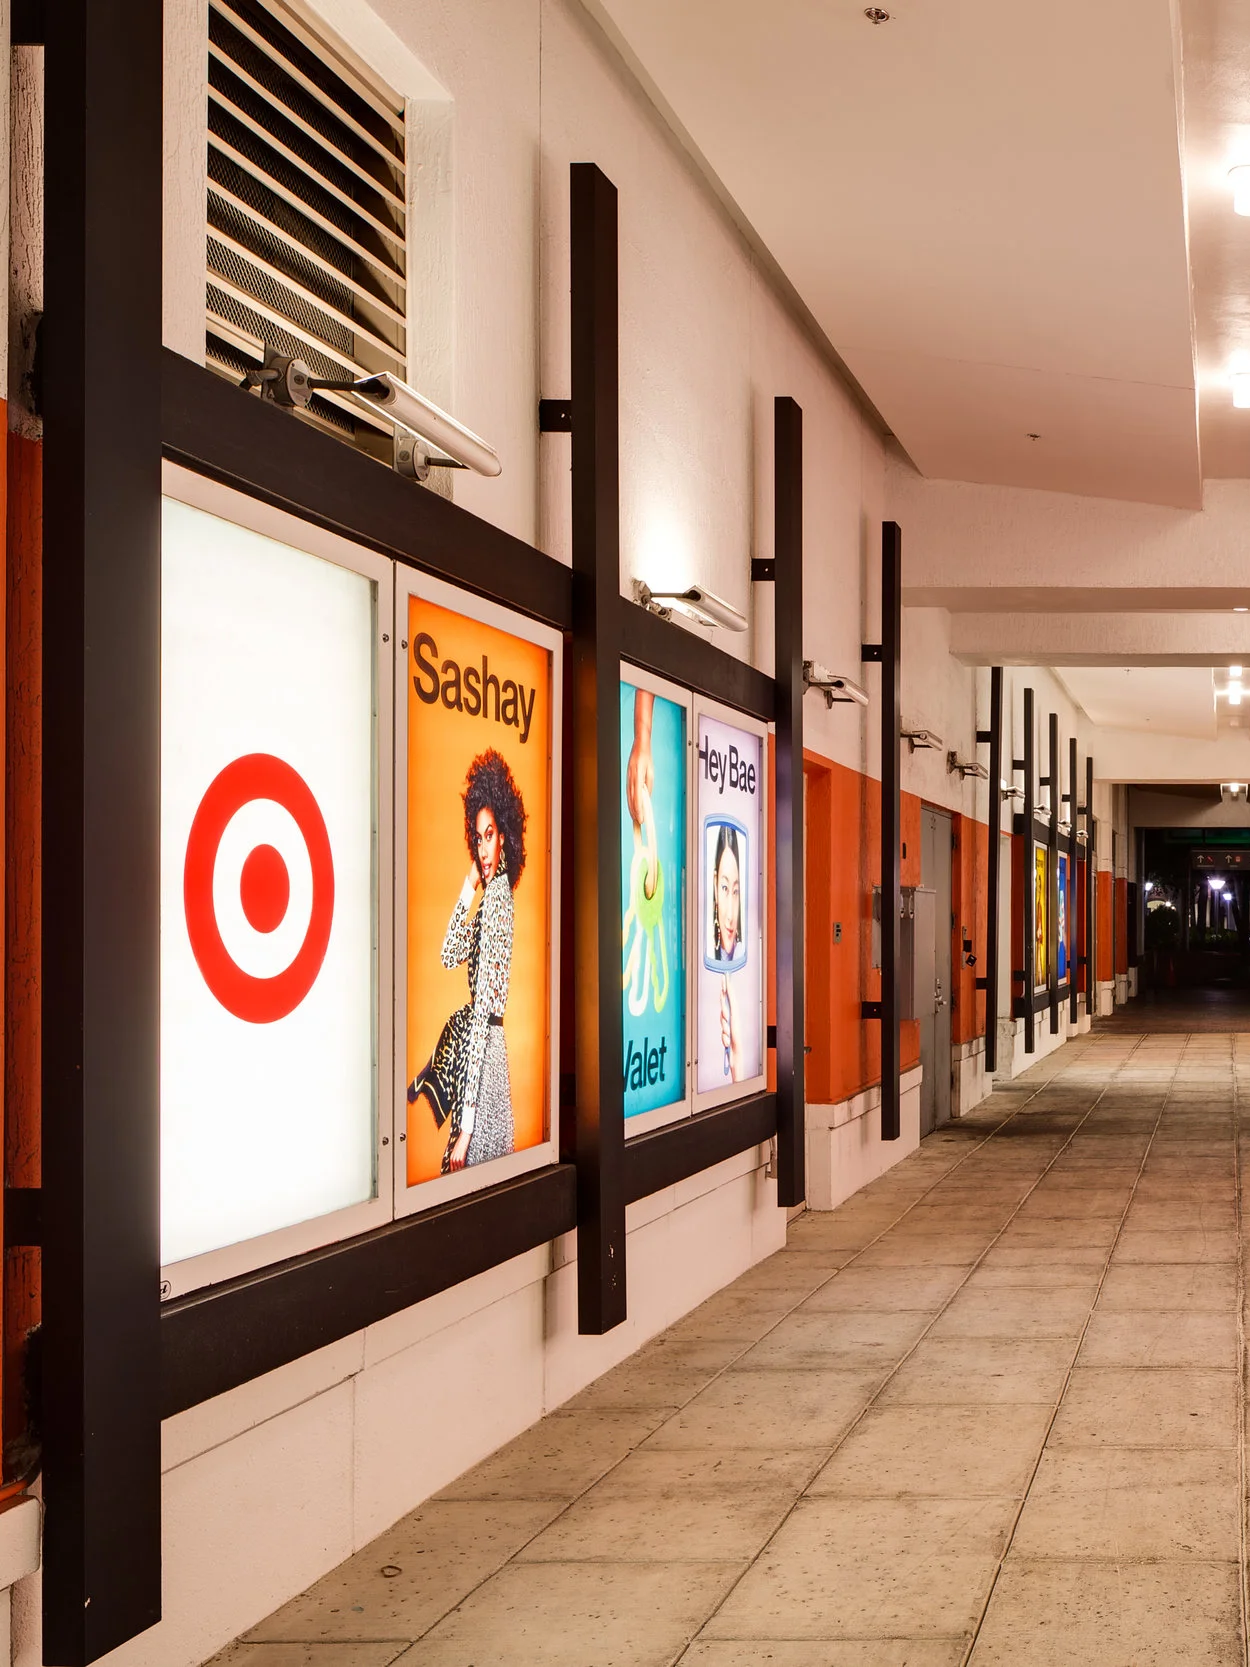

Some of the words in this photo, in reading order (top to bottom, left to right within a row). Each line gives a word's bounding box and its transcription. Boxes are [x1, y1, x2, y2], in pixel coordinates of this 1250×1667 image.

[413, 632, 536, 744] Sashay
[699, 735, 727, 795] Hey
[729, 744, 756, 795] Bae
